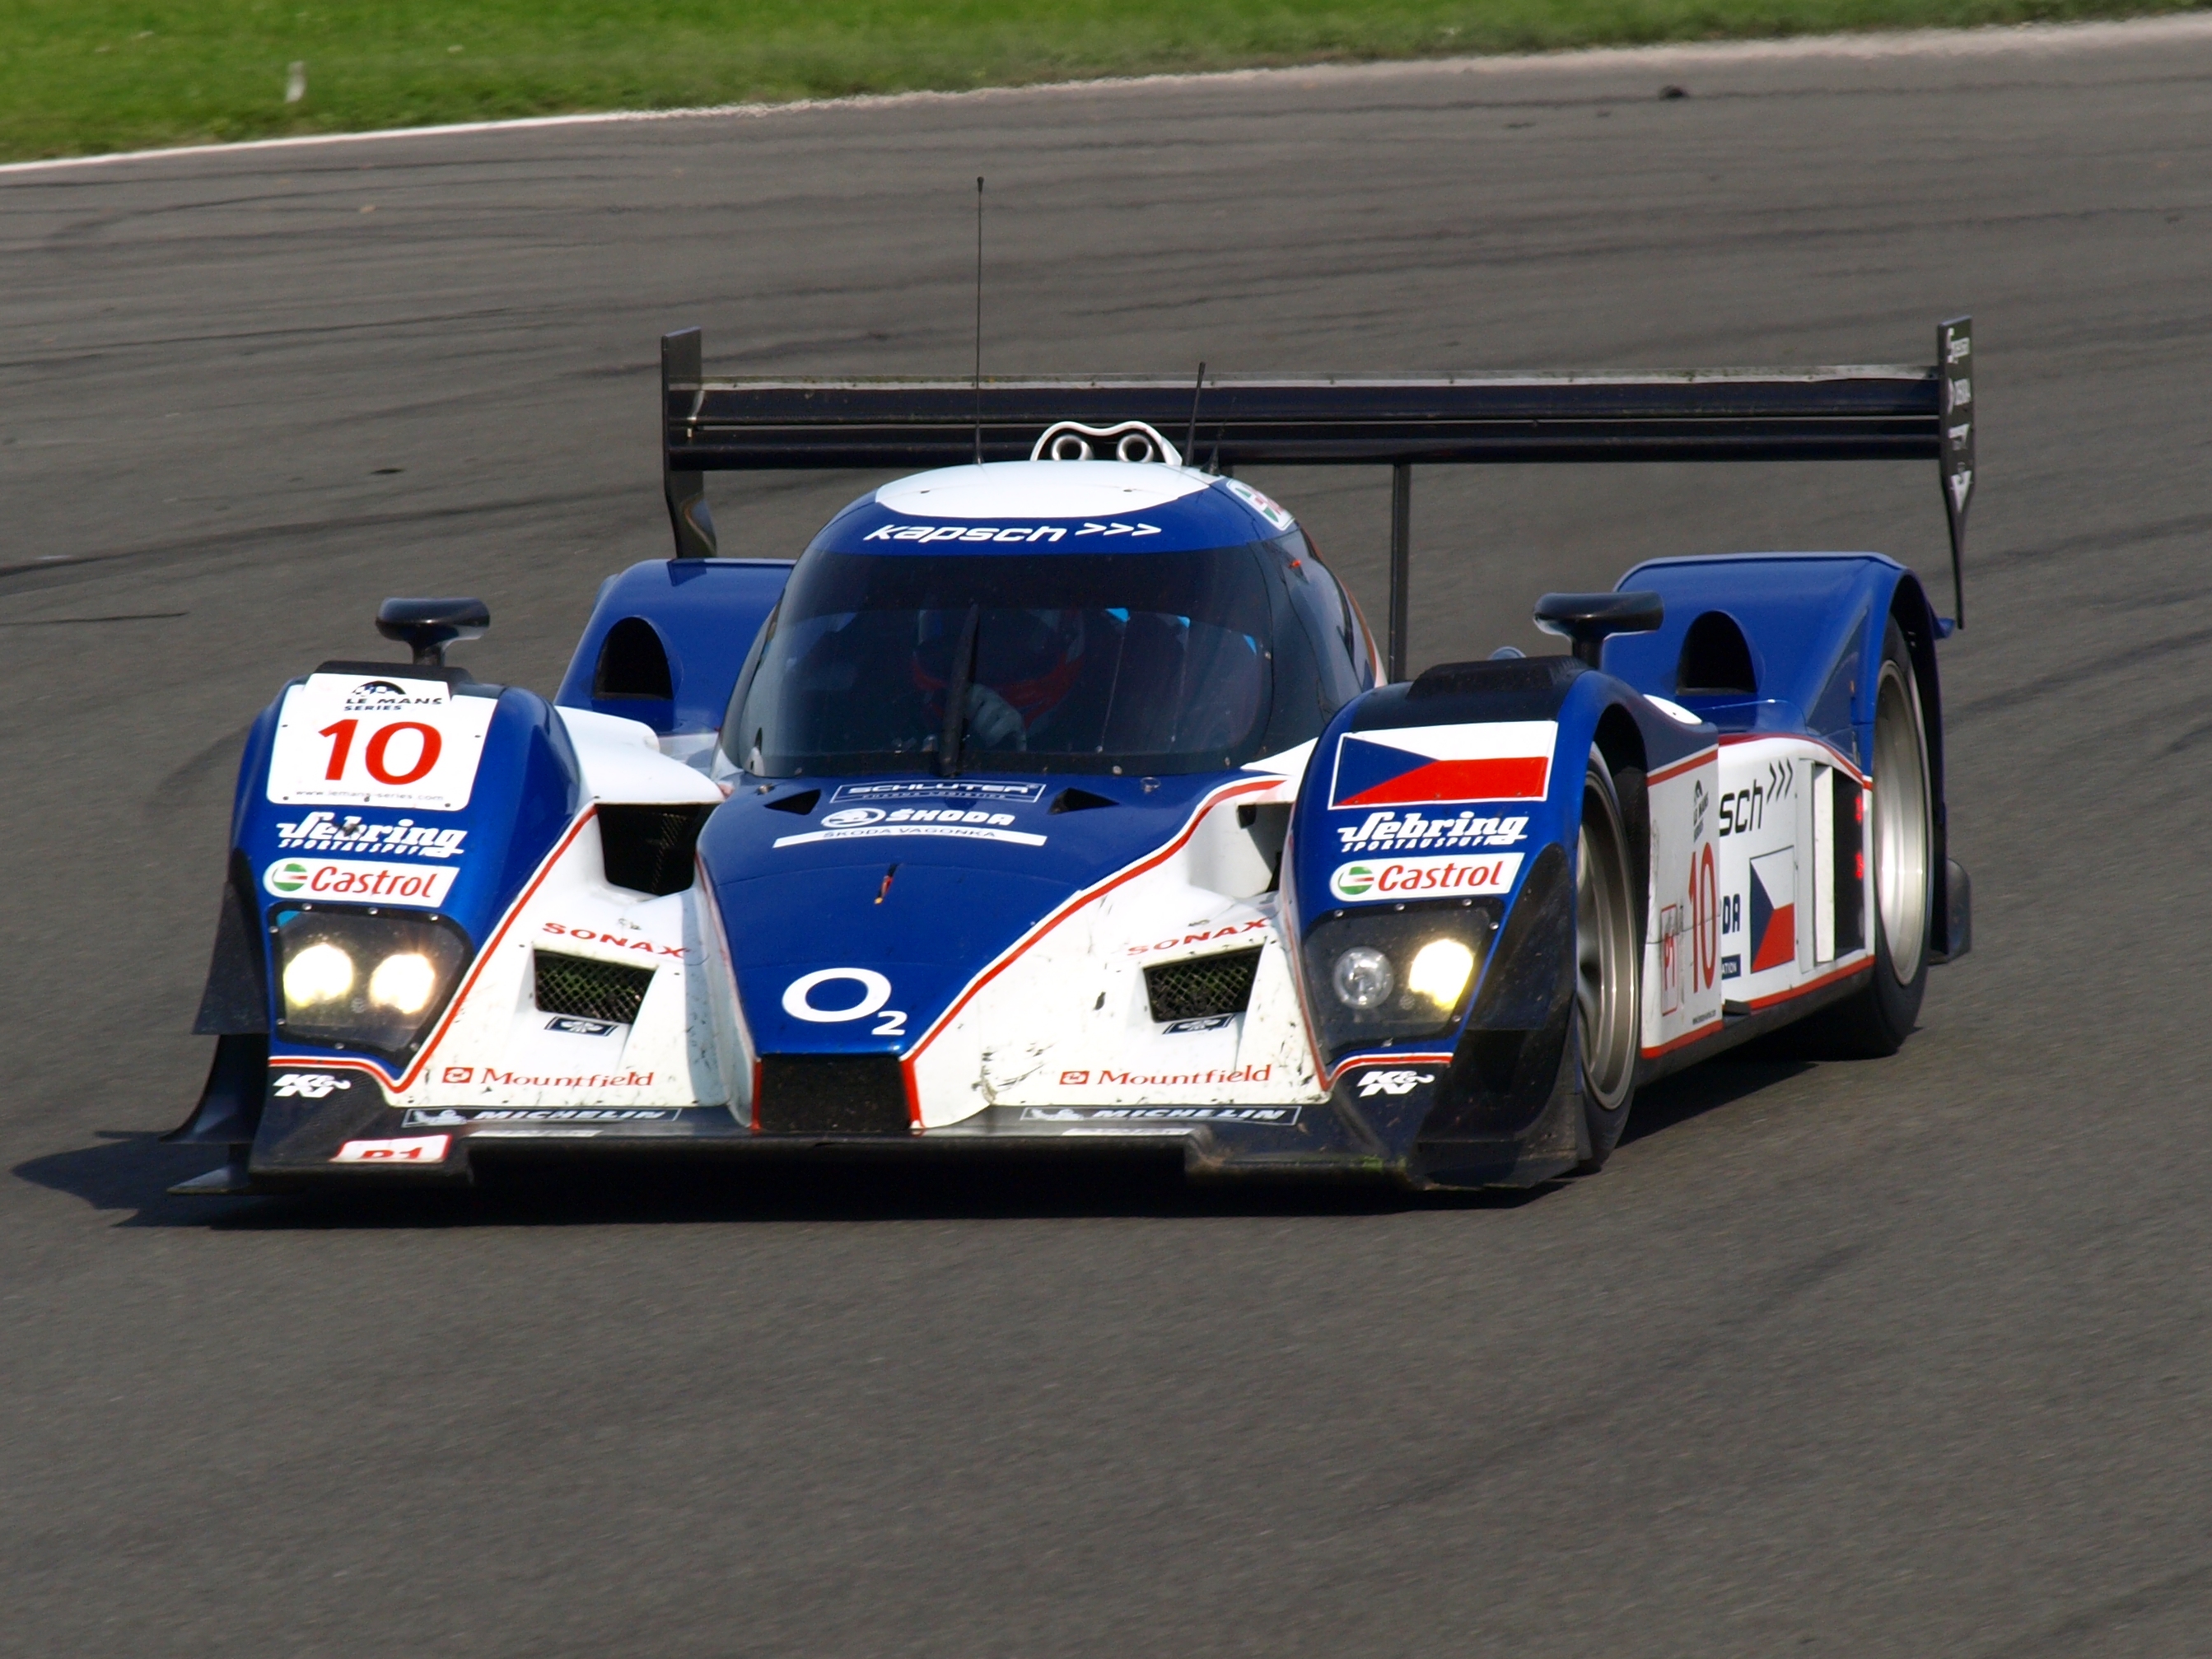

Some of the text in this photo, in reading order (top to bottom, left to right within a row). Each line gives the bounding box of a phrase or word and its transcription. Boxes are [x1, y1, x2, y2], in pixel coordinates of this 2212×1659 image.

[863, 524, 1067, 543] kapsch
[318, 719, 442, 785] 10
[276, 811, 468, 858] Sebring
[899, 827, 996, 837] VAGONKA
[1337, 811, 1529, 846] Sebring
[310, 866, 438, 897] Castrol
[1378, 860, 1504, 892] Castrol
[1688, 842, 1717, 994] 10
[542, 922, 691, 959] SONAX
[1127, 916, 1272, 957] SONAX
[481, 1068, 655, 1088] Mountfield
[1097, 1065, 1272, 1085] Mountfield
[474, 1110, 666, 1120] MICHELIN
[1092, 1109, 1287, 1121] MICHELIN
